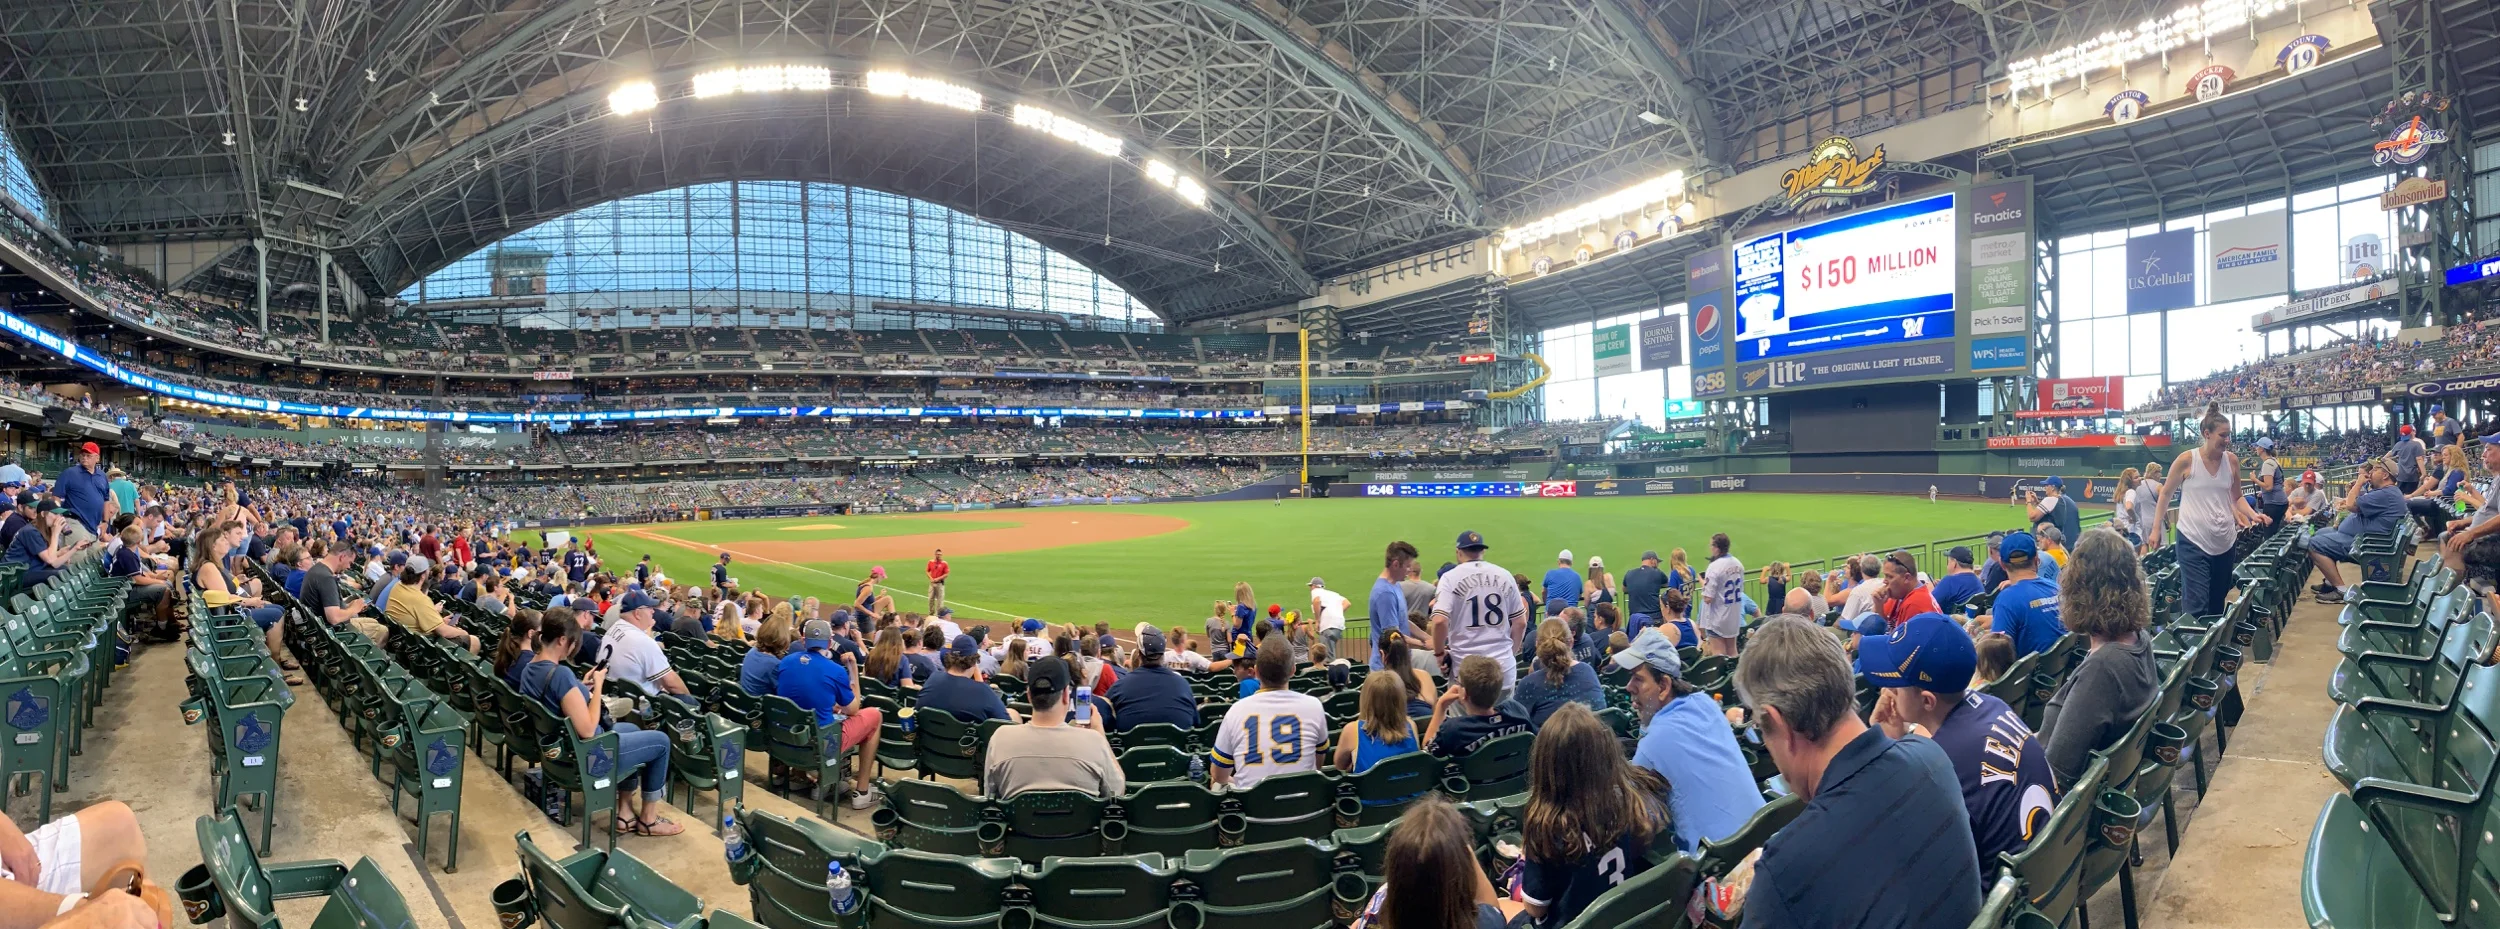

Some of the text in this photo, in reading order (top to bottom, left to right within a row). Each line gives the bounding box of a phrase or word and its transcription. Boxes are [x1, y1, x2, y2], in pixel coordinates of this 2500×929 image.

[2288, 35, 2317, 50] YOUNT
[2290, 49, 2314, 70] 19
[2195, 66, 2224, 81] UECKER
[2201, 77, 2218, 92] 50
[2110, 91, 2142, 105] MOLITOR
[2120, 104, 2129, 118] 4
[1814, 138, 1833, 156] SINCE
[1828, 143, 1884, 188] Park
[2383, 182, 2443, 209] Johnsonville
[1974, 208, 2022, 225] Fanatics
[1980, 241, 2008, 251] metro
[2348, 242, 2379, 264] Lite
[1980, 249, 2012, 259] market
[2217, 248, 2278, 264] AMERICAN FAMILY
[1801, 255, 1857, 291] $150
[1868, 245, 1937, 275] MILLION
[2221, 256, 2273, 268] INSURANCE
[2481, 260, 2500, 277] EV
[1984, 273, 2012, 283] ONLINE
[1987, 266, 2010, 276] SHOP
[1978, 280, 2018, 291] FOR MORE
[2128, 271, 2193, 290] U.S. Cellular
[1981, 288, 2016, 298] TAILGATE
[2285, 293, 2350, 316] MILLER Lite DECK
[1974, 317, 1992, 326] Pick
[2001, 316, 2023, 325] Save
[1594, 331, 1618, 343] BANK OF
[1644, 325, 1675, 338] JOURNAL
[1595, 340, 1625, 353] OUR CREW
[1643, 333, 1675, 346] SENTINEL
[1699, 342, 1721, 357] pepsi
[1973, 349, 1994, 359] WPS
[533, 372, 572, 380] RE/MAX
[1742, 355, 1944, 388] Miller Lite THE ORIGINAL LIGHT PILSNER.
[1706, 371, 1726, 391] 58
[2071, 385, 2110, 394] TOYOTA
[339, 435, 415, 445] WELCOME
[431, 438, 451, 446] TO
[1989, 436, 2058, 447] TOYOTA TERRITORY
[2018, 457, 2065, 469] buyatoyota.com
[1375, 472, 1407, 480] FRIDAYS
[1367, 485, 1394, 495] 12:46
[1710, 477, 1746, 491] meijer
[2093, 485, 2116, 493] POTAW
[573, 557, 585, 568] 22
[1452, 572, 1513, 599] MOUSTAKAS
[1724, 577, 1742, 604] 22
[1465, 592, 1504, 628] 18
[1029, 646, 1042, 655] SLE
[1242, 713, 1303, 766] 19
[1597, 846, 1626, 886] 3
